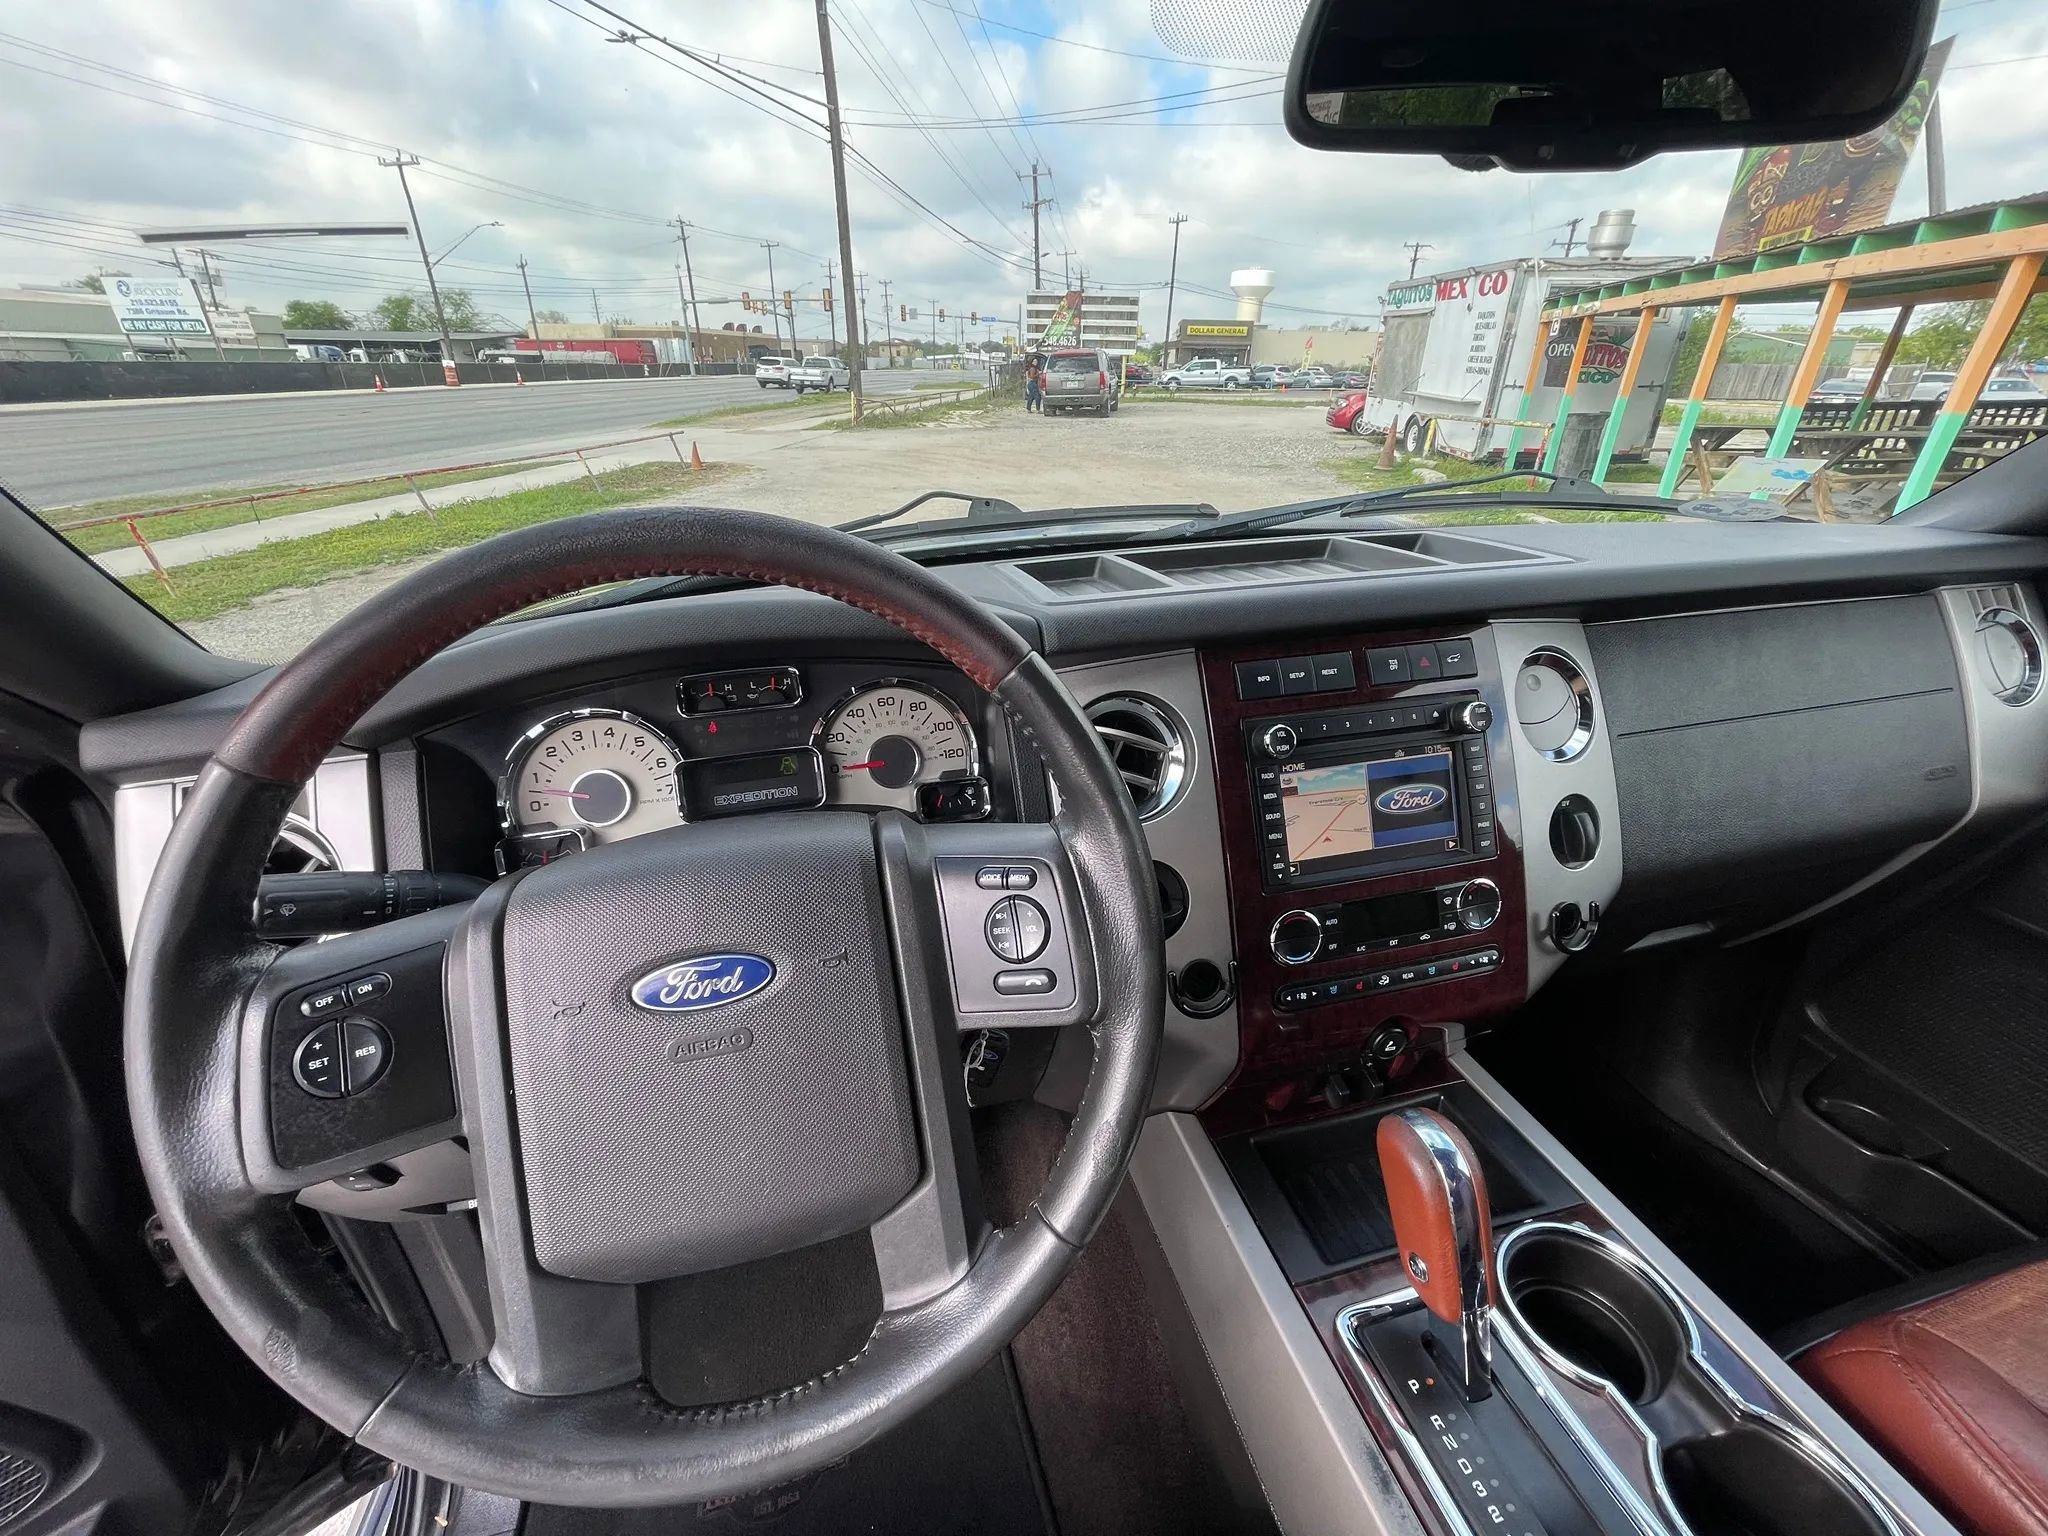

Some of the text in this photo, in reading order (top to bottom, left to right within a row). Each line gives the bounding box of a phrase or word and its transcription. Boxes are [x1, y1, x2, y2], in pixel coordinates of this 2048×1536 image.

[1387, 284, 1433, 309] TAQUITOS
[1478, 271, 1508, 297] CO
[122, 320, 206, 331] WE PAY CASH FOR METAL
[1190, 326, 1246, 335] DOLLAR GENERAL
[1548, 342, 1576, 357] OPEN
[1289, 672, 1305, 680] SETUP
[1322, 668, 1338, 676] RESET
[784, 678, 792, 686] H
[877, 696, 895, 708] 60
[909, 701, 928, 712] 80
[846, 708, 865, 719] 40
[604, 727, 616, 738] 4
[932, 721, 954, 733] 100
[572, 730, 583, 742] 3
[634, 736, 646, 748] 5
[826, 732, 844, 744] 20
[546, 746, 558, 758] 2
[942, 748, 965, 760] 120
[1276, 744, 1290, 752] PUSH
[656, 757, 668, 768] 6
[830, 763, 840, 774] 0
[1282, 762, 1306, 772] HOME
[532, 772, 539, 784] 1
[665, 784, 674, 794] 7
[714, 786, 798, 806] EXPEDITION
[1390, 788, 1433, 810] Ford
[529, 800, 542, 812] 0
[970, 799, 977, 807] F
[980, 874, 1002, 882] VOICE
[992, 926, 1010, 935] SEEK
[660, 962, 744, 1004] Ford
[315, 984, 372, 1008] OFF ON
[674, 1033, 745, 1058] AIRBAG
[355, 1046, 376, 1058] RES
[308, 1057, 330, 1070] SET
[1407, 1378, 1504, 1524] P R N D 3 2
